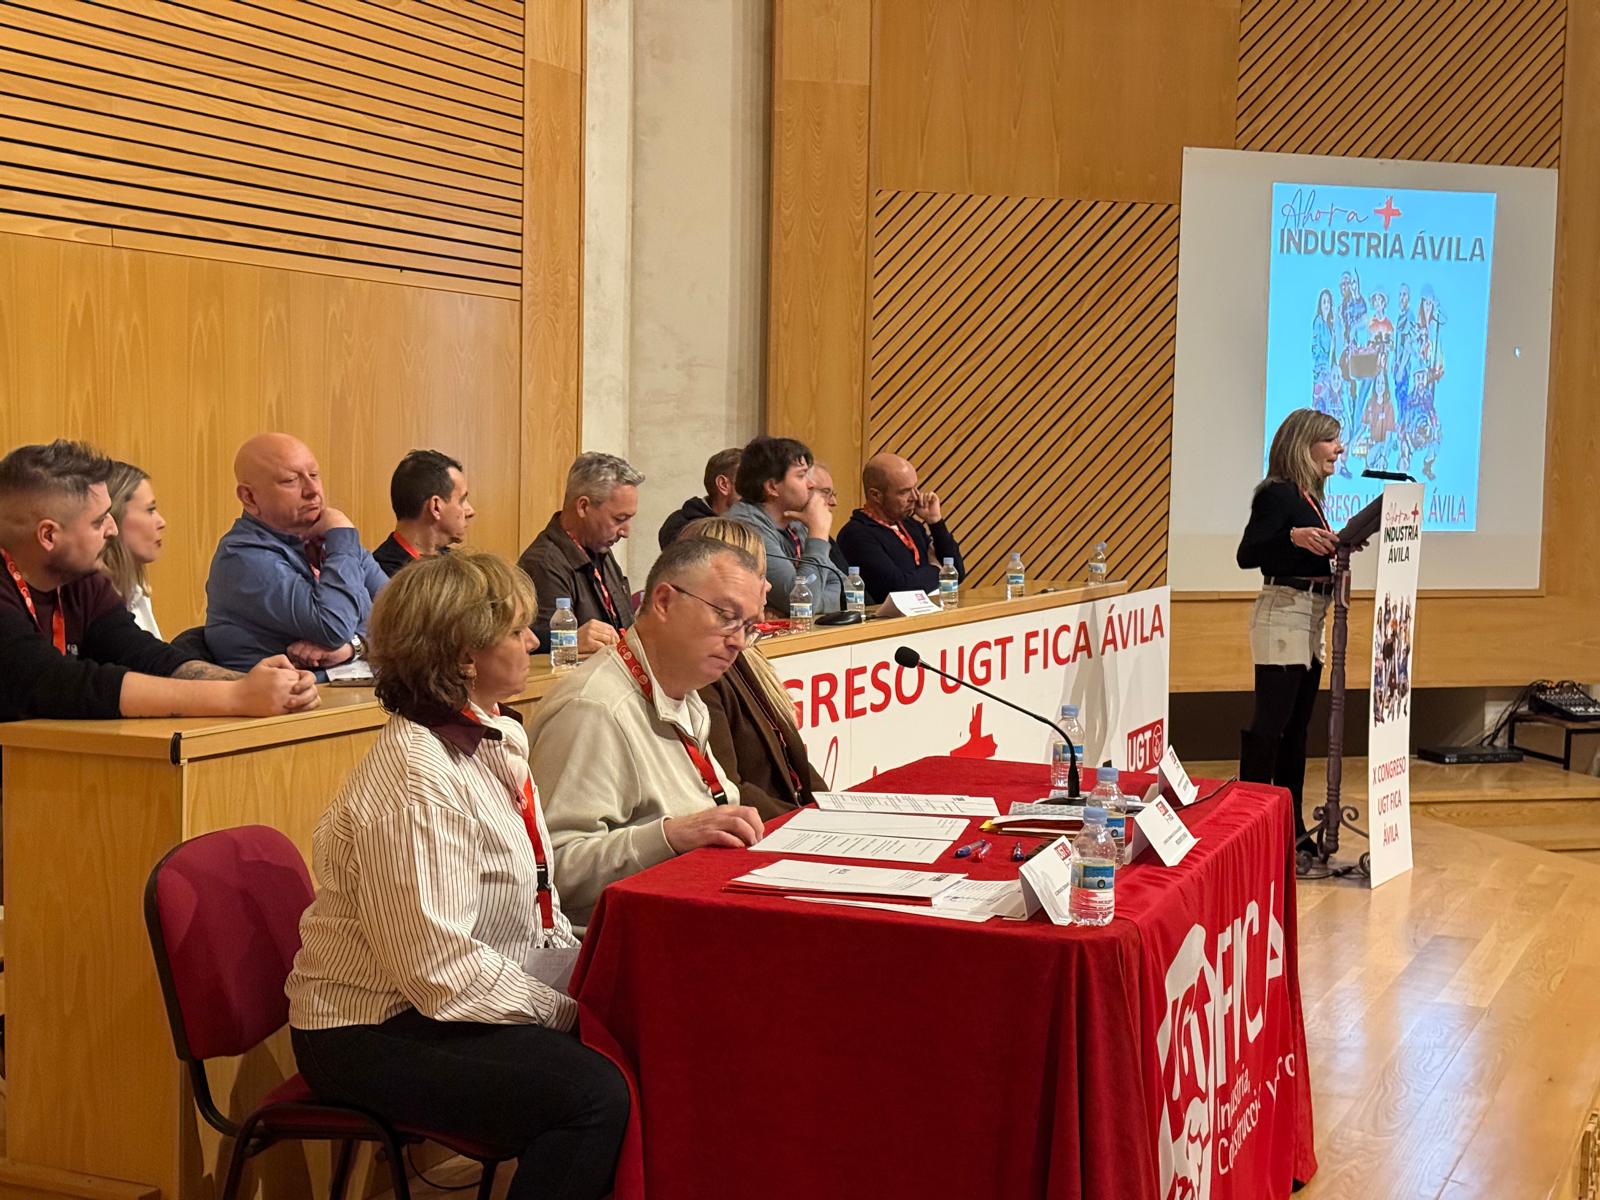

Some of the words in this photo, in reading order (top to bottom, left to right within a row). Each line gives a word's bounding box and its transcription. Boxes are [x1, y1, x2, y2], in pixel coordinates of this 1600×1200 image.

[1281, 188, 1369, 236] Ahora
[1279, 228, 1405, 259] INDUSTRIA
[1411, 229, 1485, 261] ÁVILA
[1320, 494, 1361, 523] RESO
[1428, 486, 1466, 522] ÁVILA
[1384, 524, 1419, 543] INDUSTRIA
[1388, 545, 1410, 564] ÁVILA
[940, 635, 1014, 694] UGT
[1024, 620, 1093, 674] FICA
[1101, 603, 1165, 656] ÁVILA
[1128, 730, 1152, 772] UGT
